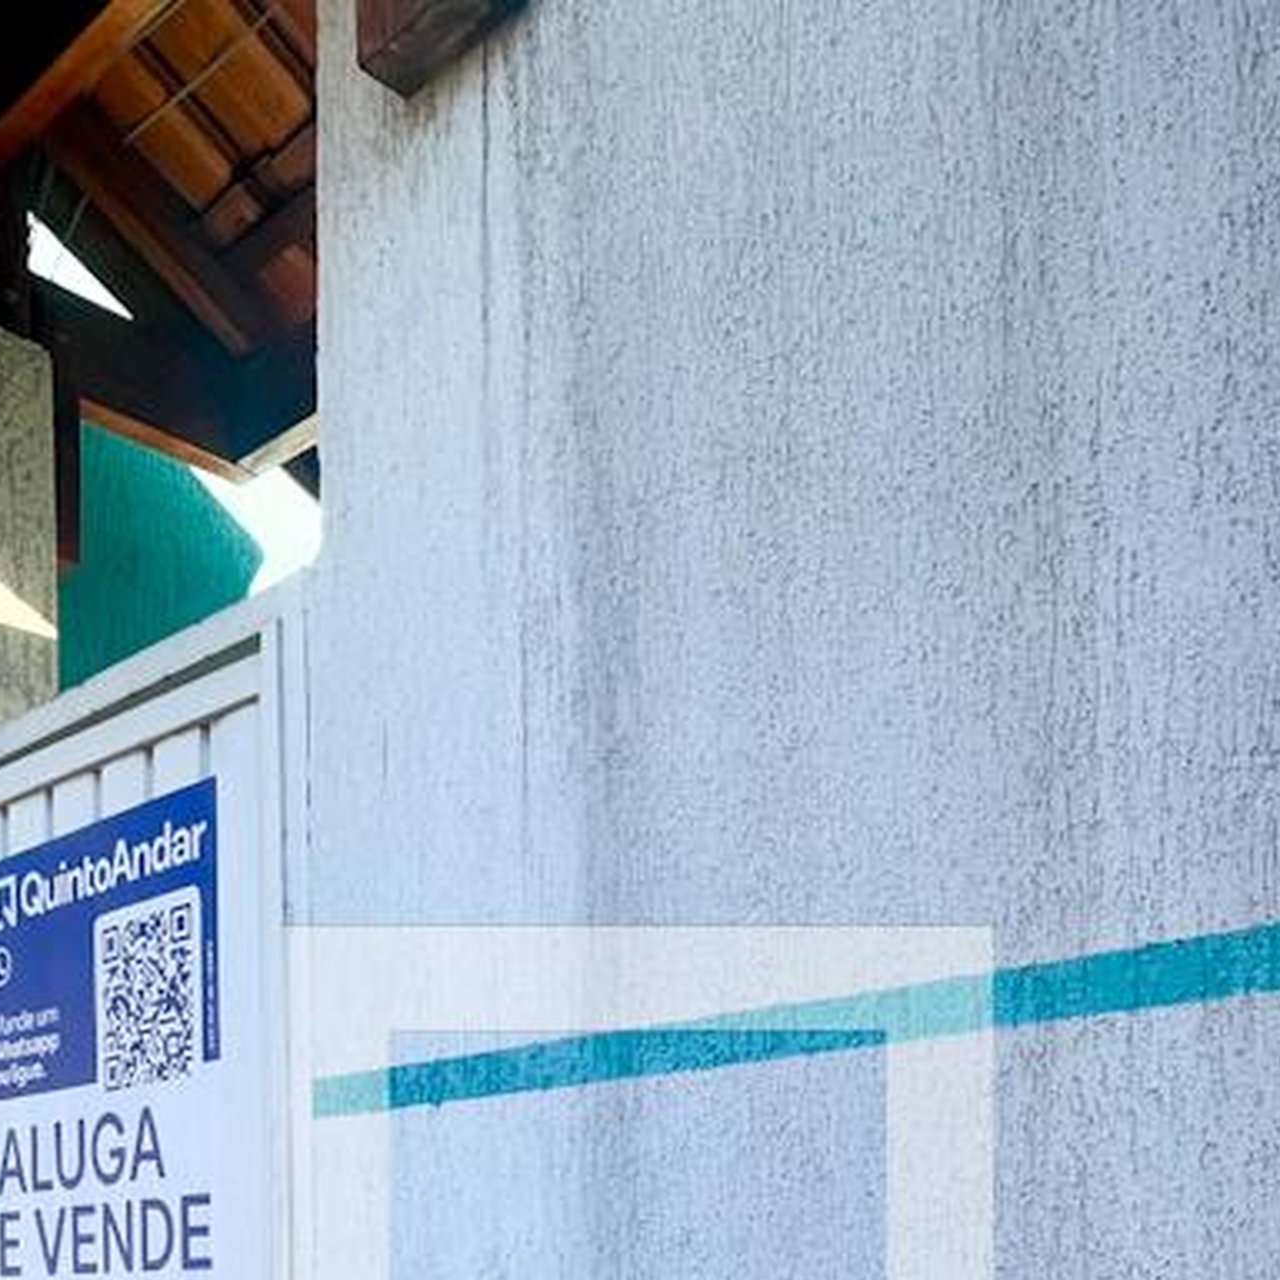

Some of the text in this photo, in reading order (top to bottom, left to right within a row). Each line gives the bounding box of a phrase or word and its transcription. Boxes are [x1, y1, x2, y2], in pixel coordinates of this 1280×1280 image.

[20, 819, 207, 917] QuintoAndar
[0, 1193, 213, 1276] E VENDE
